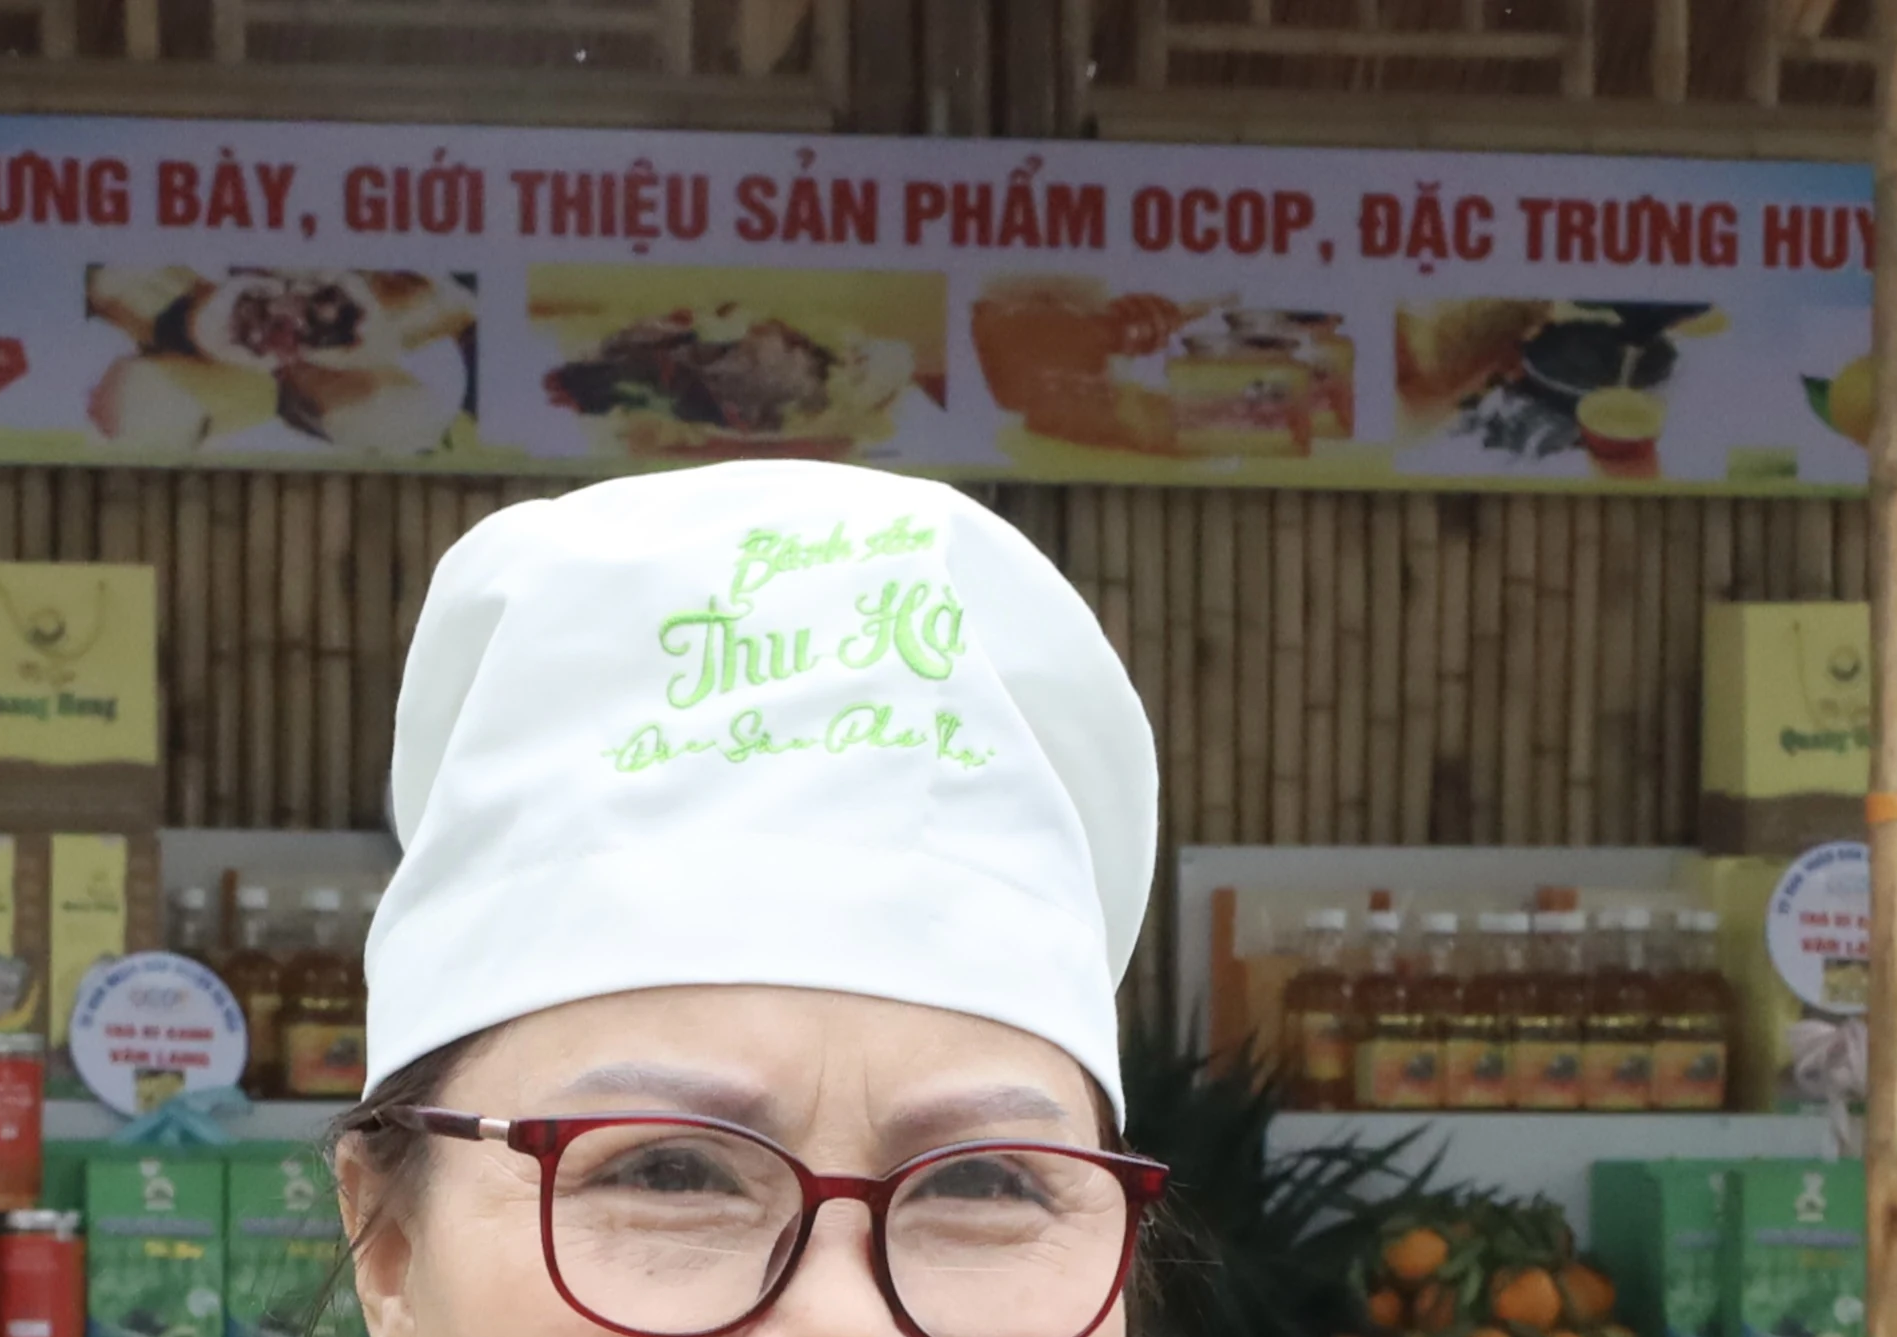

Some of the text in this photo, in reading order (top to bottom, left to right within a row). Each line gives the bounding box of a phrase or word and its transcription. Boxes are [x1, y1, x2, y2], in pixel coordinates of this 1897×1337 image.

[159, 146, 317, 238] BÀY,
[344, 147, 485, 236] GIỚI
[510, 158, 709, 255] THIỆU
[734, 147, 877, 245] SẢN
[905, 154, 1104, 250] PHẨM
[1130, 187, 1335, 264] OCOP,
[1359, 180, 1493, 276] ĐẶC
[1519, 192, 1739, 270] TRƯNG
[658, 580, 966, 710] Thu Hà
